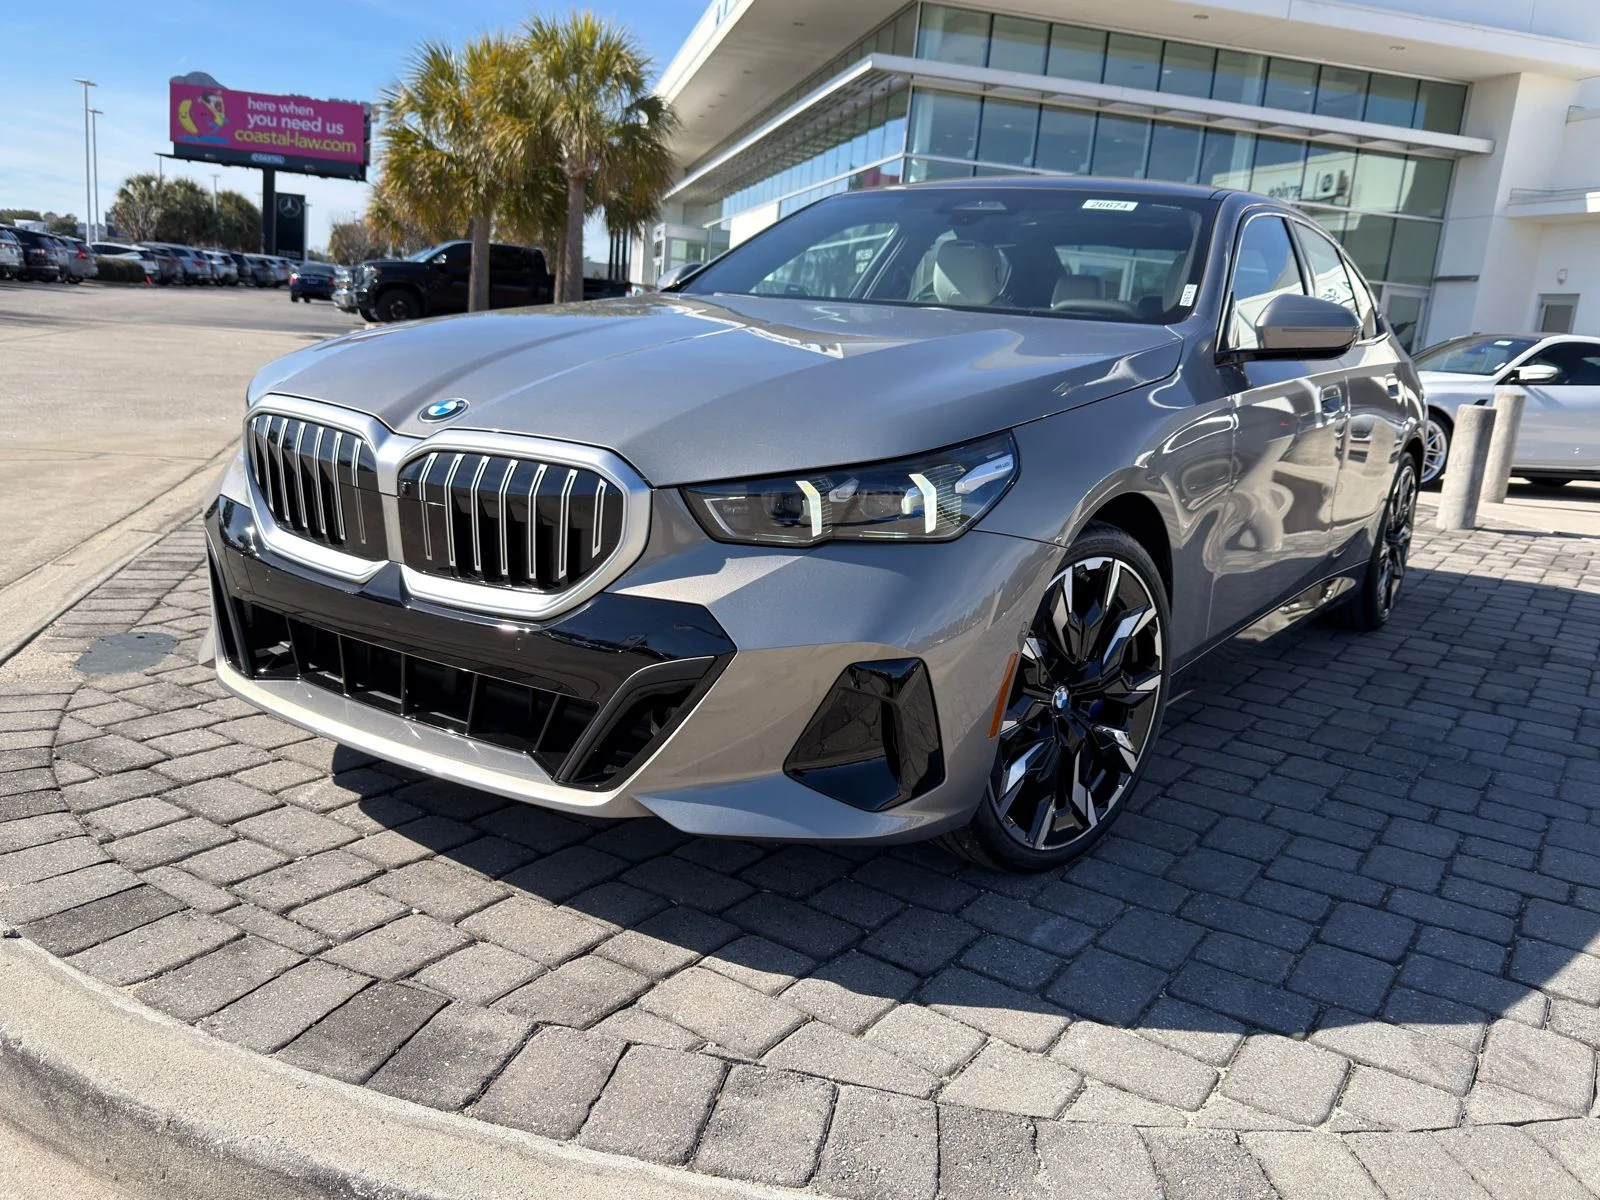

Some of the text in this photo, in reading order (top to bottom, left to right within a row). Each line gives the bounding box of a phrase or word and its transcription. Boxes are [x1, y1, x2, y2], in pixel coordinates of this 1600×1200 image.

[247, 96, 314, 117] here when
[247, 113, 345, 135] you need us
[234, 129, 357, 154] coastal-law.com
[1089, 201, 1129, 209] 26674
